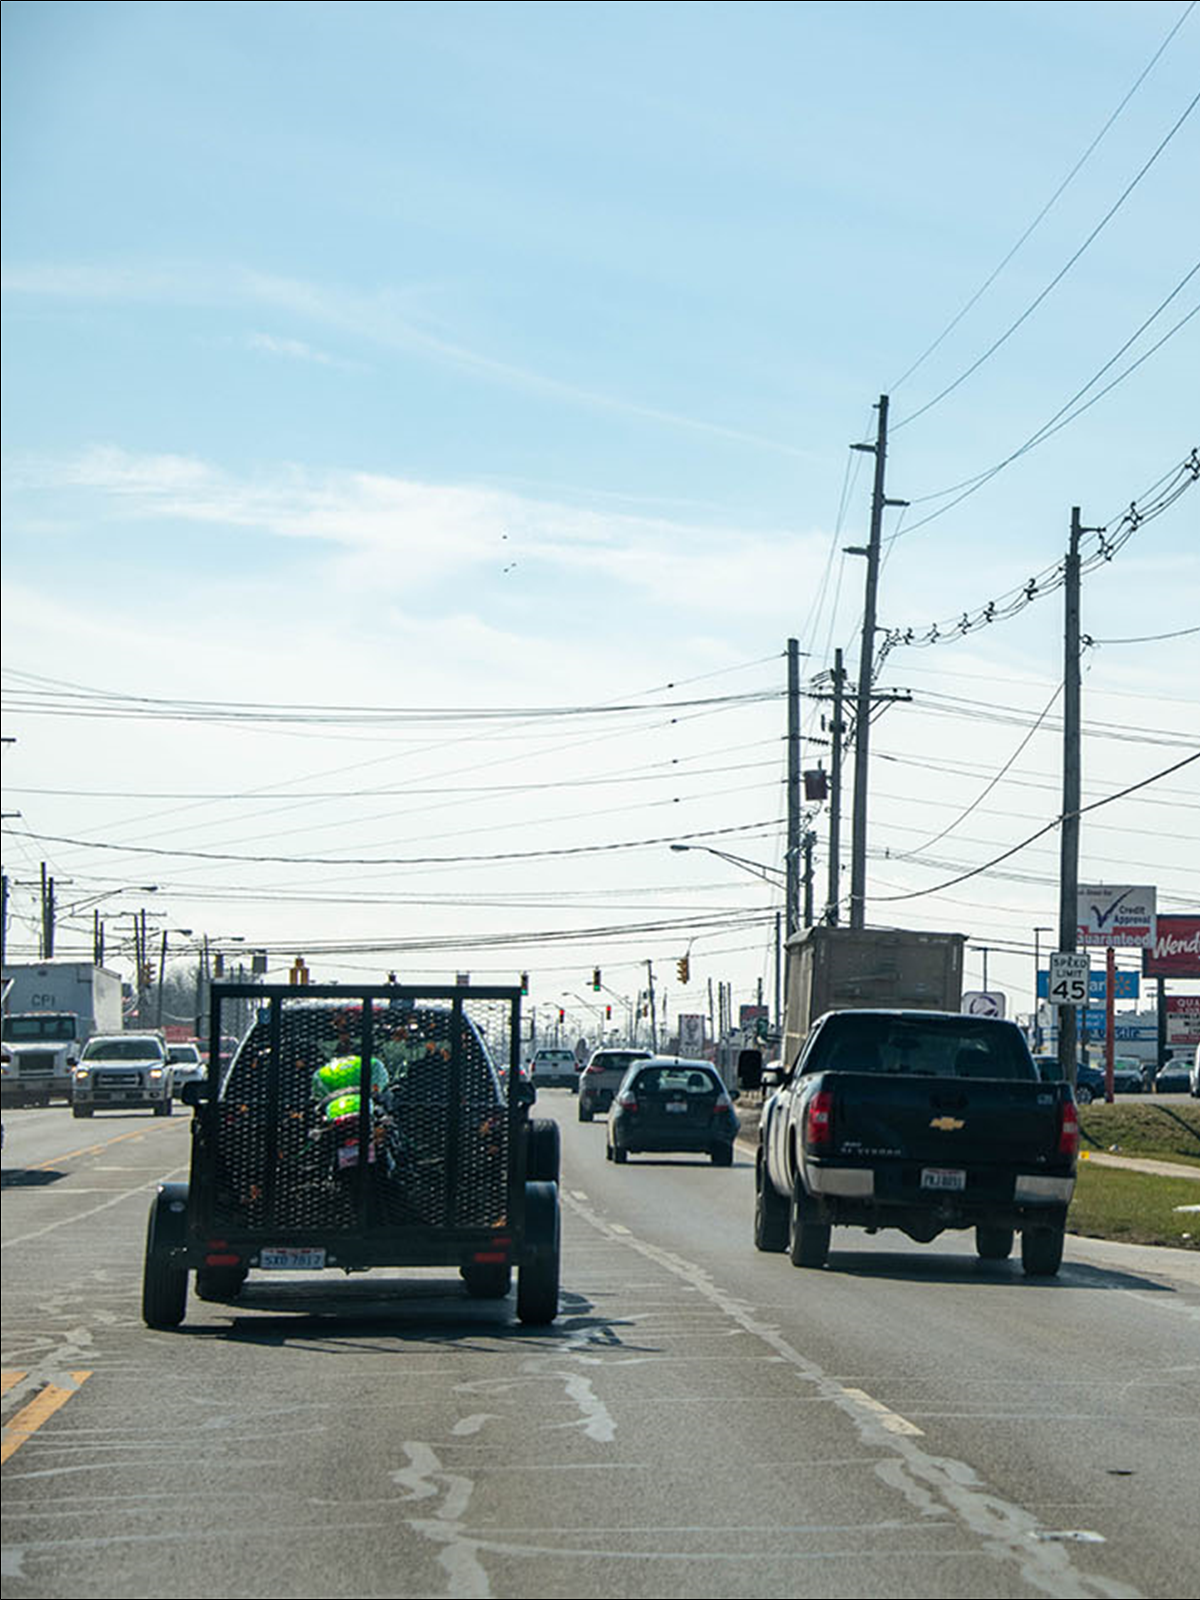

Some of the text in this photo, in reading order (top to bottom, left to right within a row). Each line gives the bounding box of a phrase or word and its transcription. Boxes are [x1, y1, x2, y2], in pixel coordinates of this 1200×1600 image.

[1119, 905, 1145, 915] Credit
[1113, 914, 1151, 926] Approval
[1077, 928, 1150, 947] Guaranteed
[1053, 956, 1087, 968] SPEED
[1056, 969, 1083, 978] LIMIT
[1052, 980, 1085, 1000] 45
[31, 993, 55, 1007] CPI
